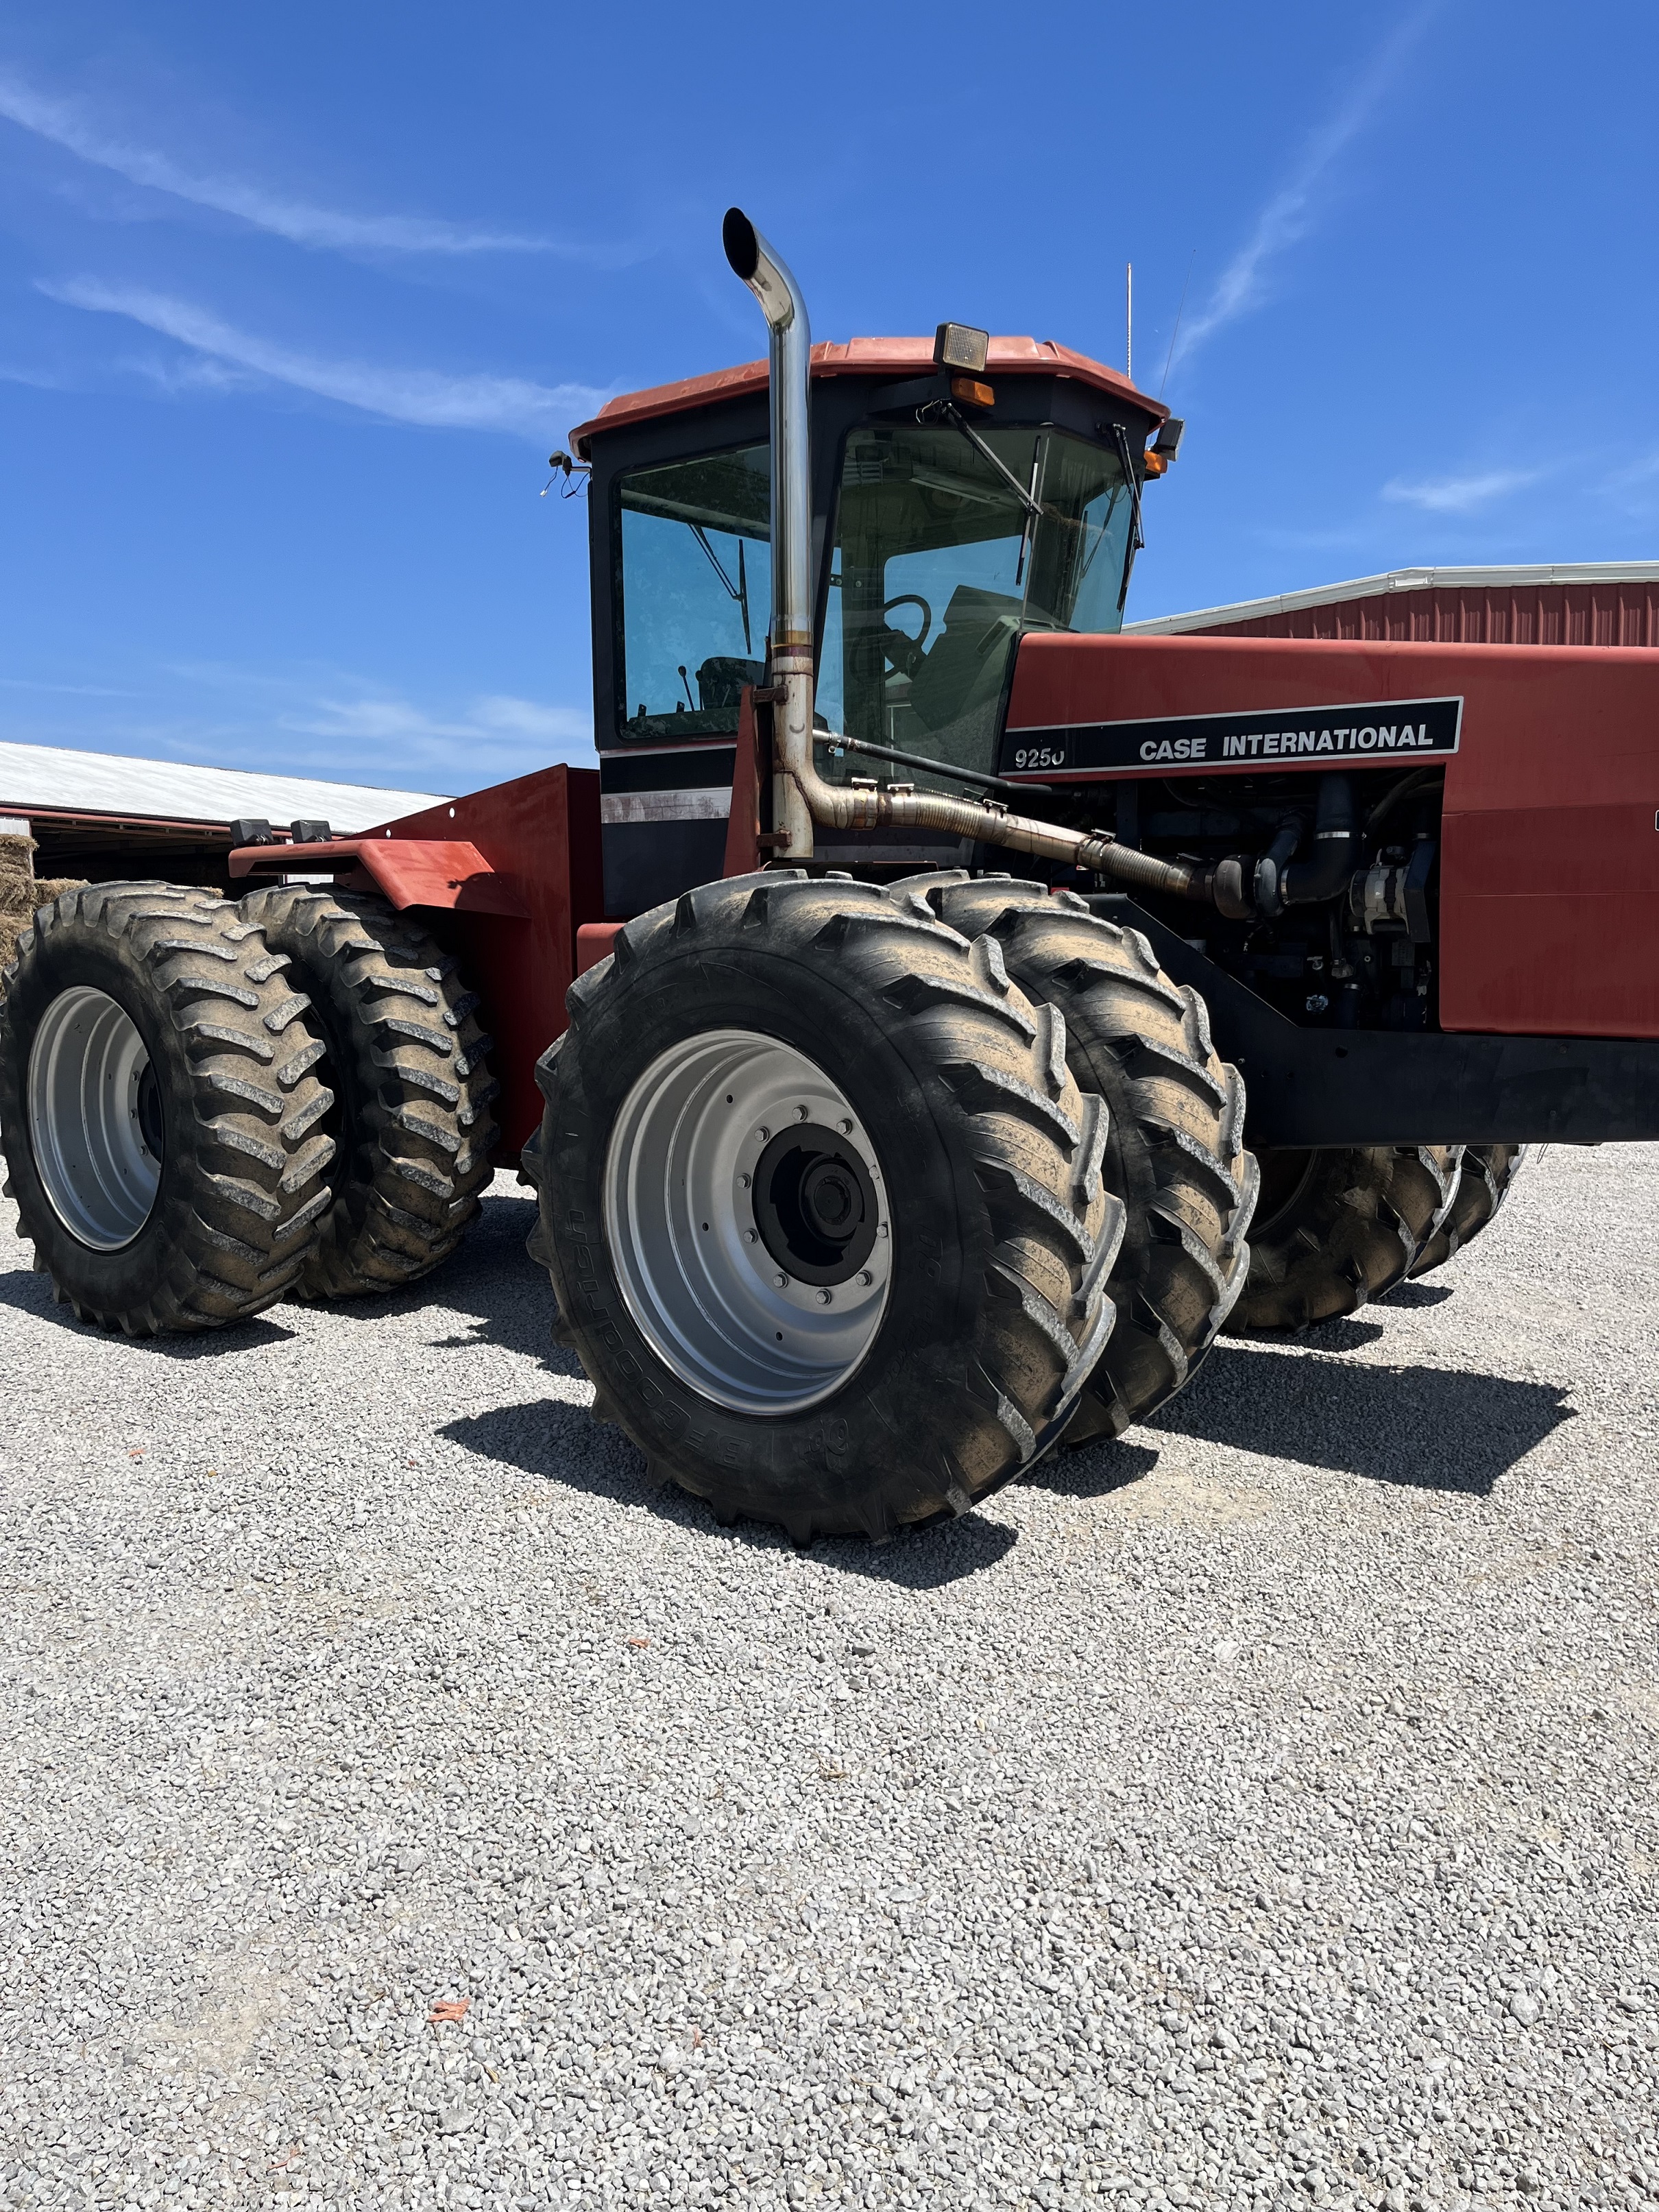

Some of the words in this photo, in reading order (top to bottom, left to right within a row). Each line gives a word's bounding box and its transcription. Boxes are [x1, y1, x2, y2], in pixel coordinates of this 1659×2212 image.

[1015, 747, 1065, 768] 9250
[1139, 738, 1207, 760] CASE
[1222, 724, 1433, 756] INTERNATIONAL
[566, 1208, 752, 1469] BFGoodrich
